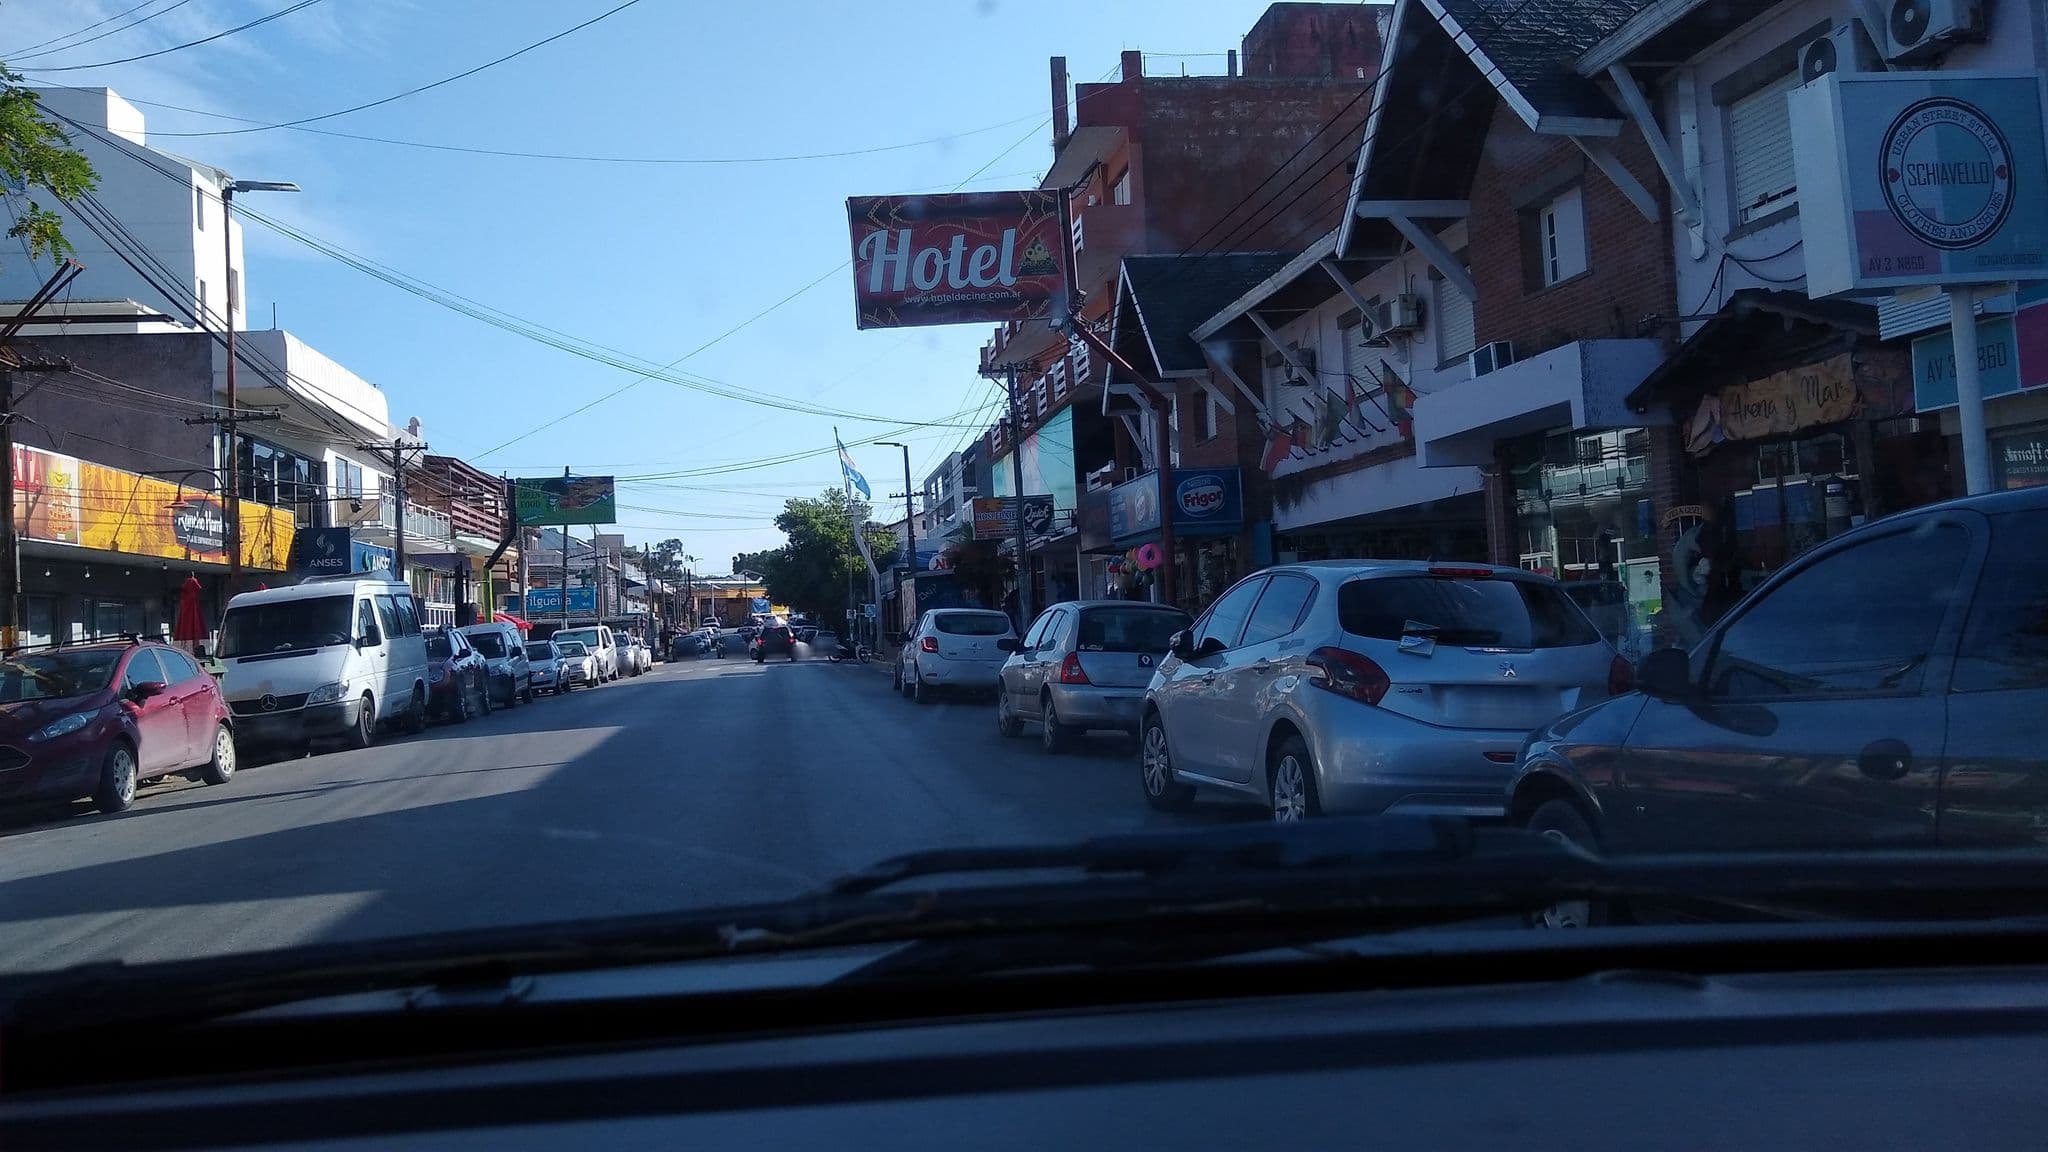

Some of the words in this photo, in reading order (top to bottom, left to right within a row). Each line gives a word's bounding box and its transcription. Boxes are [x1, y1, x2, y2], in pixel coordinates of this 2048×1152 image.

[1893, 117, 1921, 156] URBAN
[1921, 109, 1967, 124] STREET
[1967, 119, 2000, 154] STYLE
[1906, 162, 1990, 186] SCHIAVELLO
[1897, 193, 1947, 238] CLOTHES
[1949, 224, 1977, 239] AND
[1976, 191, 2004, 231] SHOES
[858, 228, 1017, 294] Hotel
[904, 291, 1022, 304] www.hoteldecine.com.ar
[1927, 359, 1943, 384] AV
[1731, 393, 1778, 424] Arena
[1785, 394, 1797, 425] y
[1800, 375, 1844, 408] Mar
[1183, 490, 1223, 508] Frigor
[309, 558, 343, 567] ANSES
